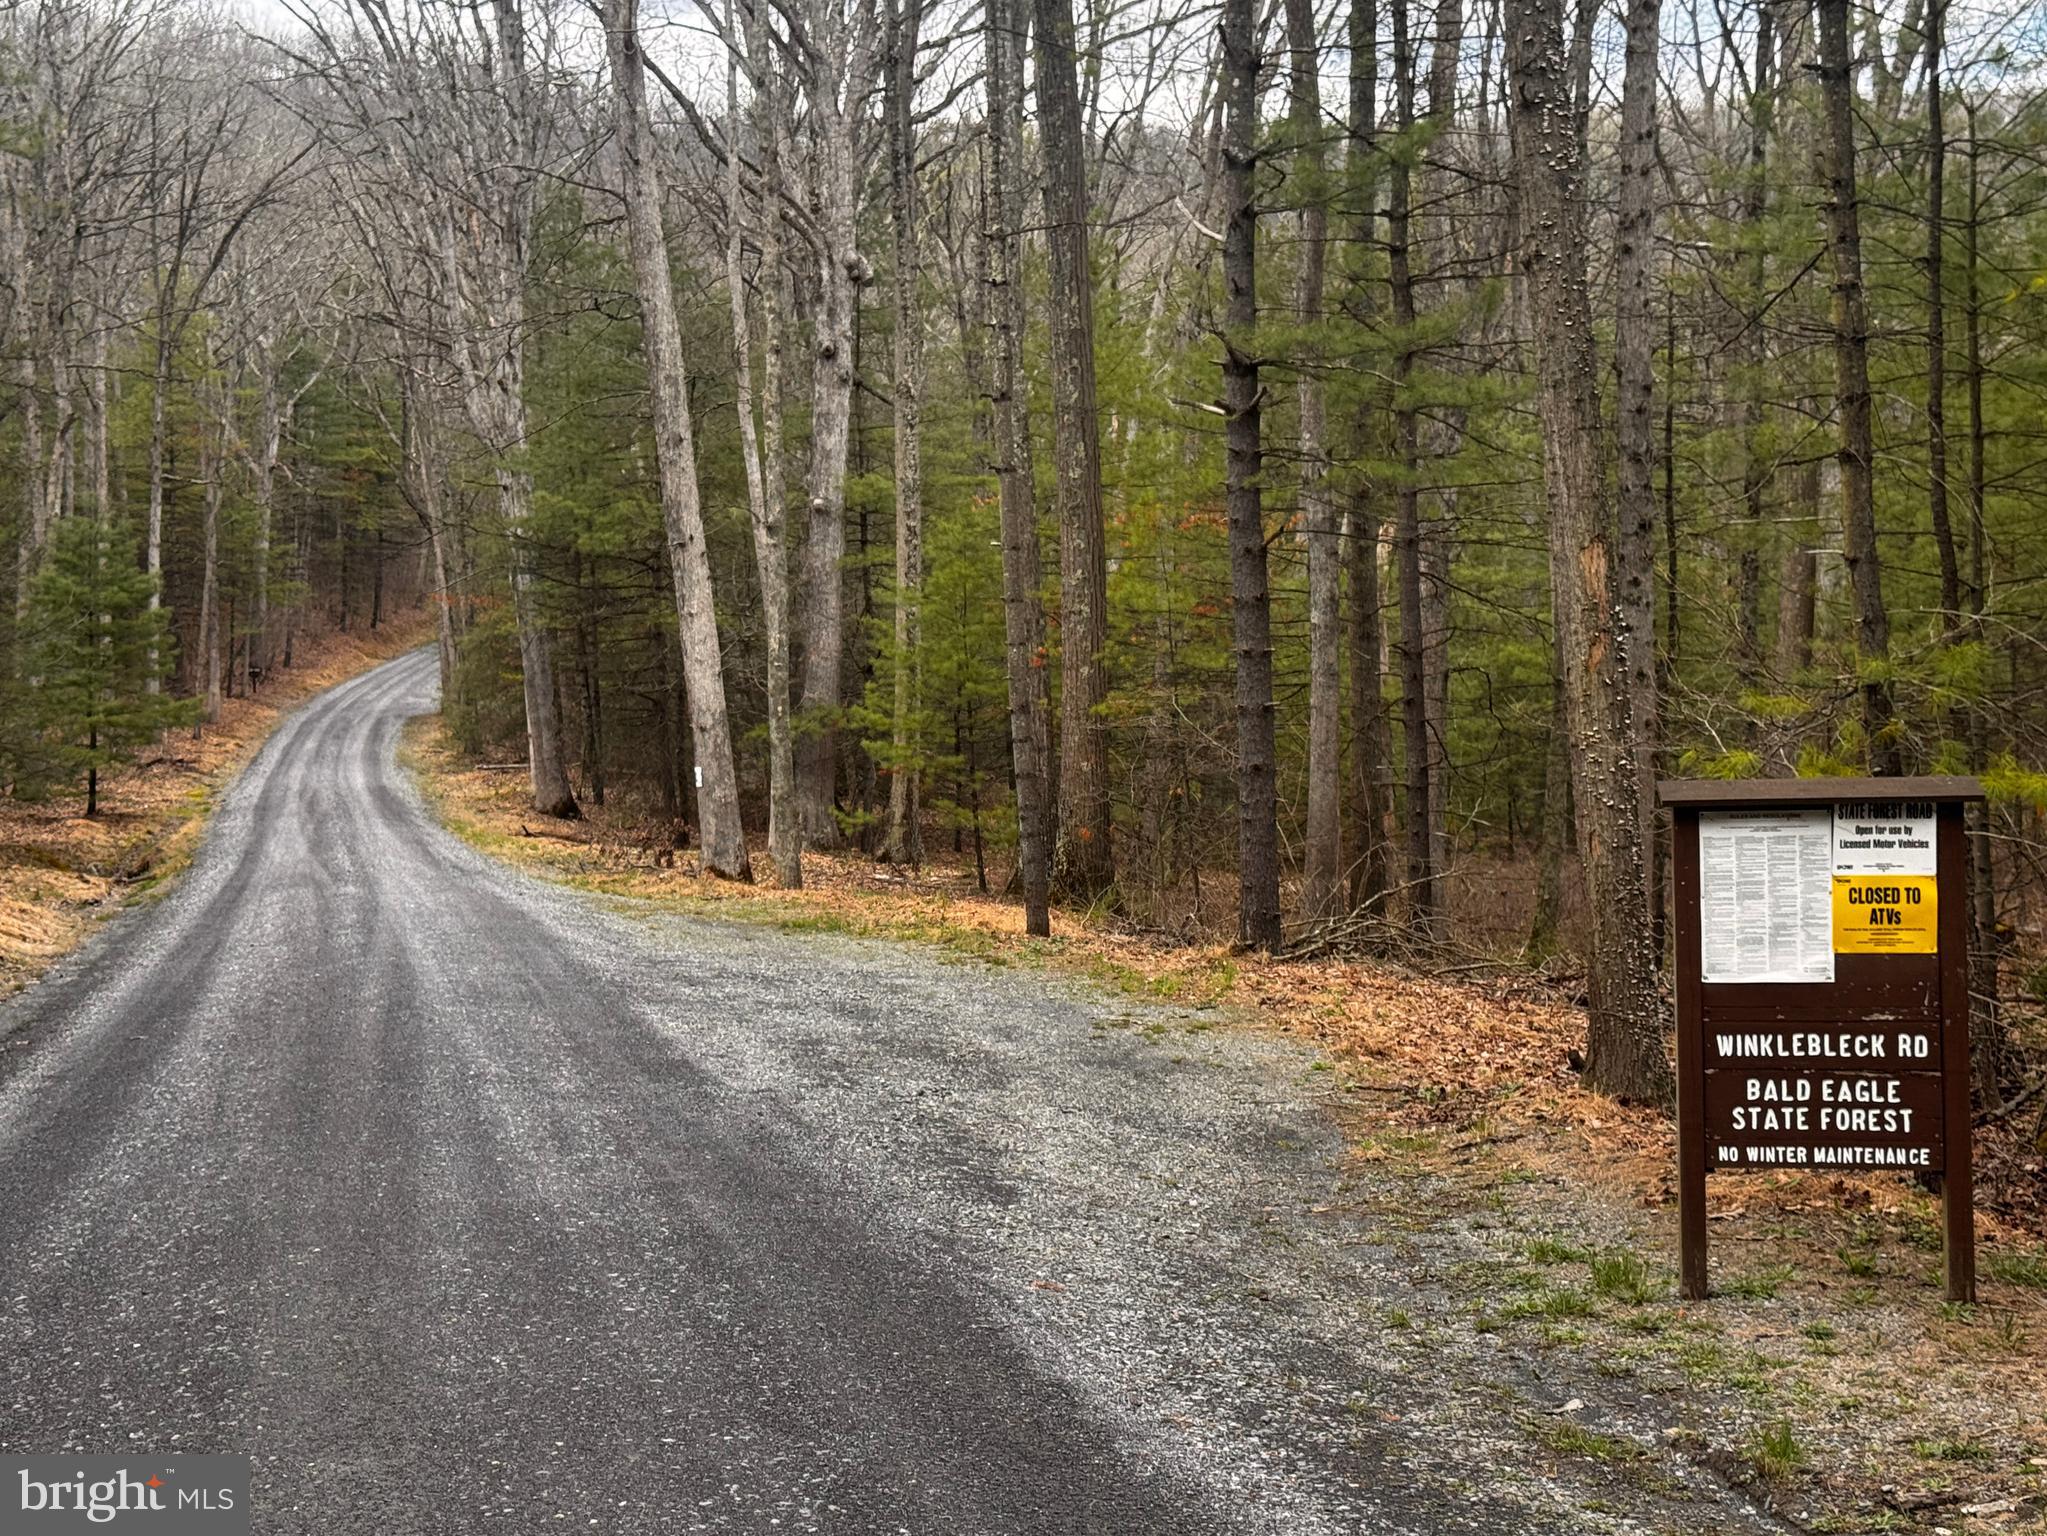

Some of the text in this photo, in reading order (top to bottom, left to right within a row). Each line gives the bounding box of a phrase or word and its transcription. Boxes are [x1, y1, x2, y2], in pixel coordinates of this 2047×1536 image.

[1838, 803, 1933, 820] STATE FOREST ROAD
[1855, 825, 1913, 836] Open for use by
[1840, 839, 1929, 849] Licensed Motor Vehicles
[1849, 887, 1921, 904] CLOSED TO
[1869, 908, 1902, 925] ATVs
[1716, 1034, 1929, 1058] WINKLEBLECK RD
[1747, 1079, 1901, 1103] BALD EAGLE
[1732, 1107, 1913, 1133] STATE FOREST
[1718, 1146, 1930, 1165] NO WINTER MAINTENANCE
